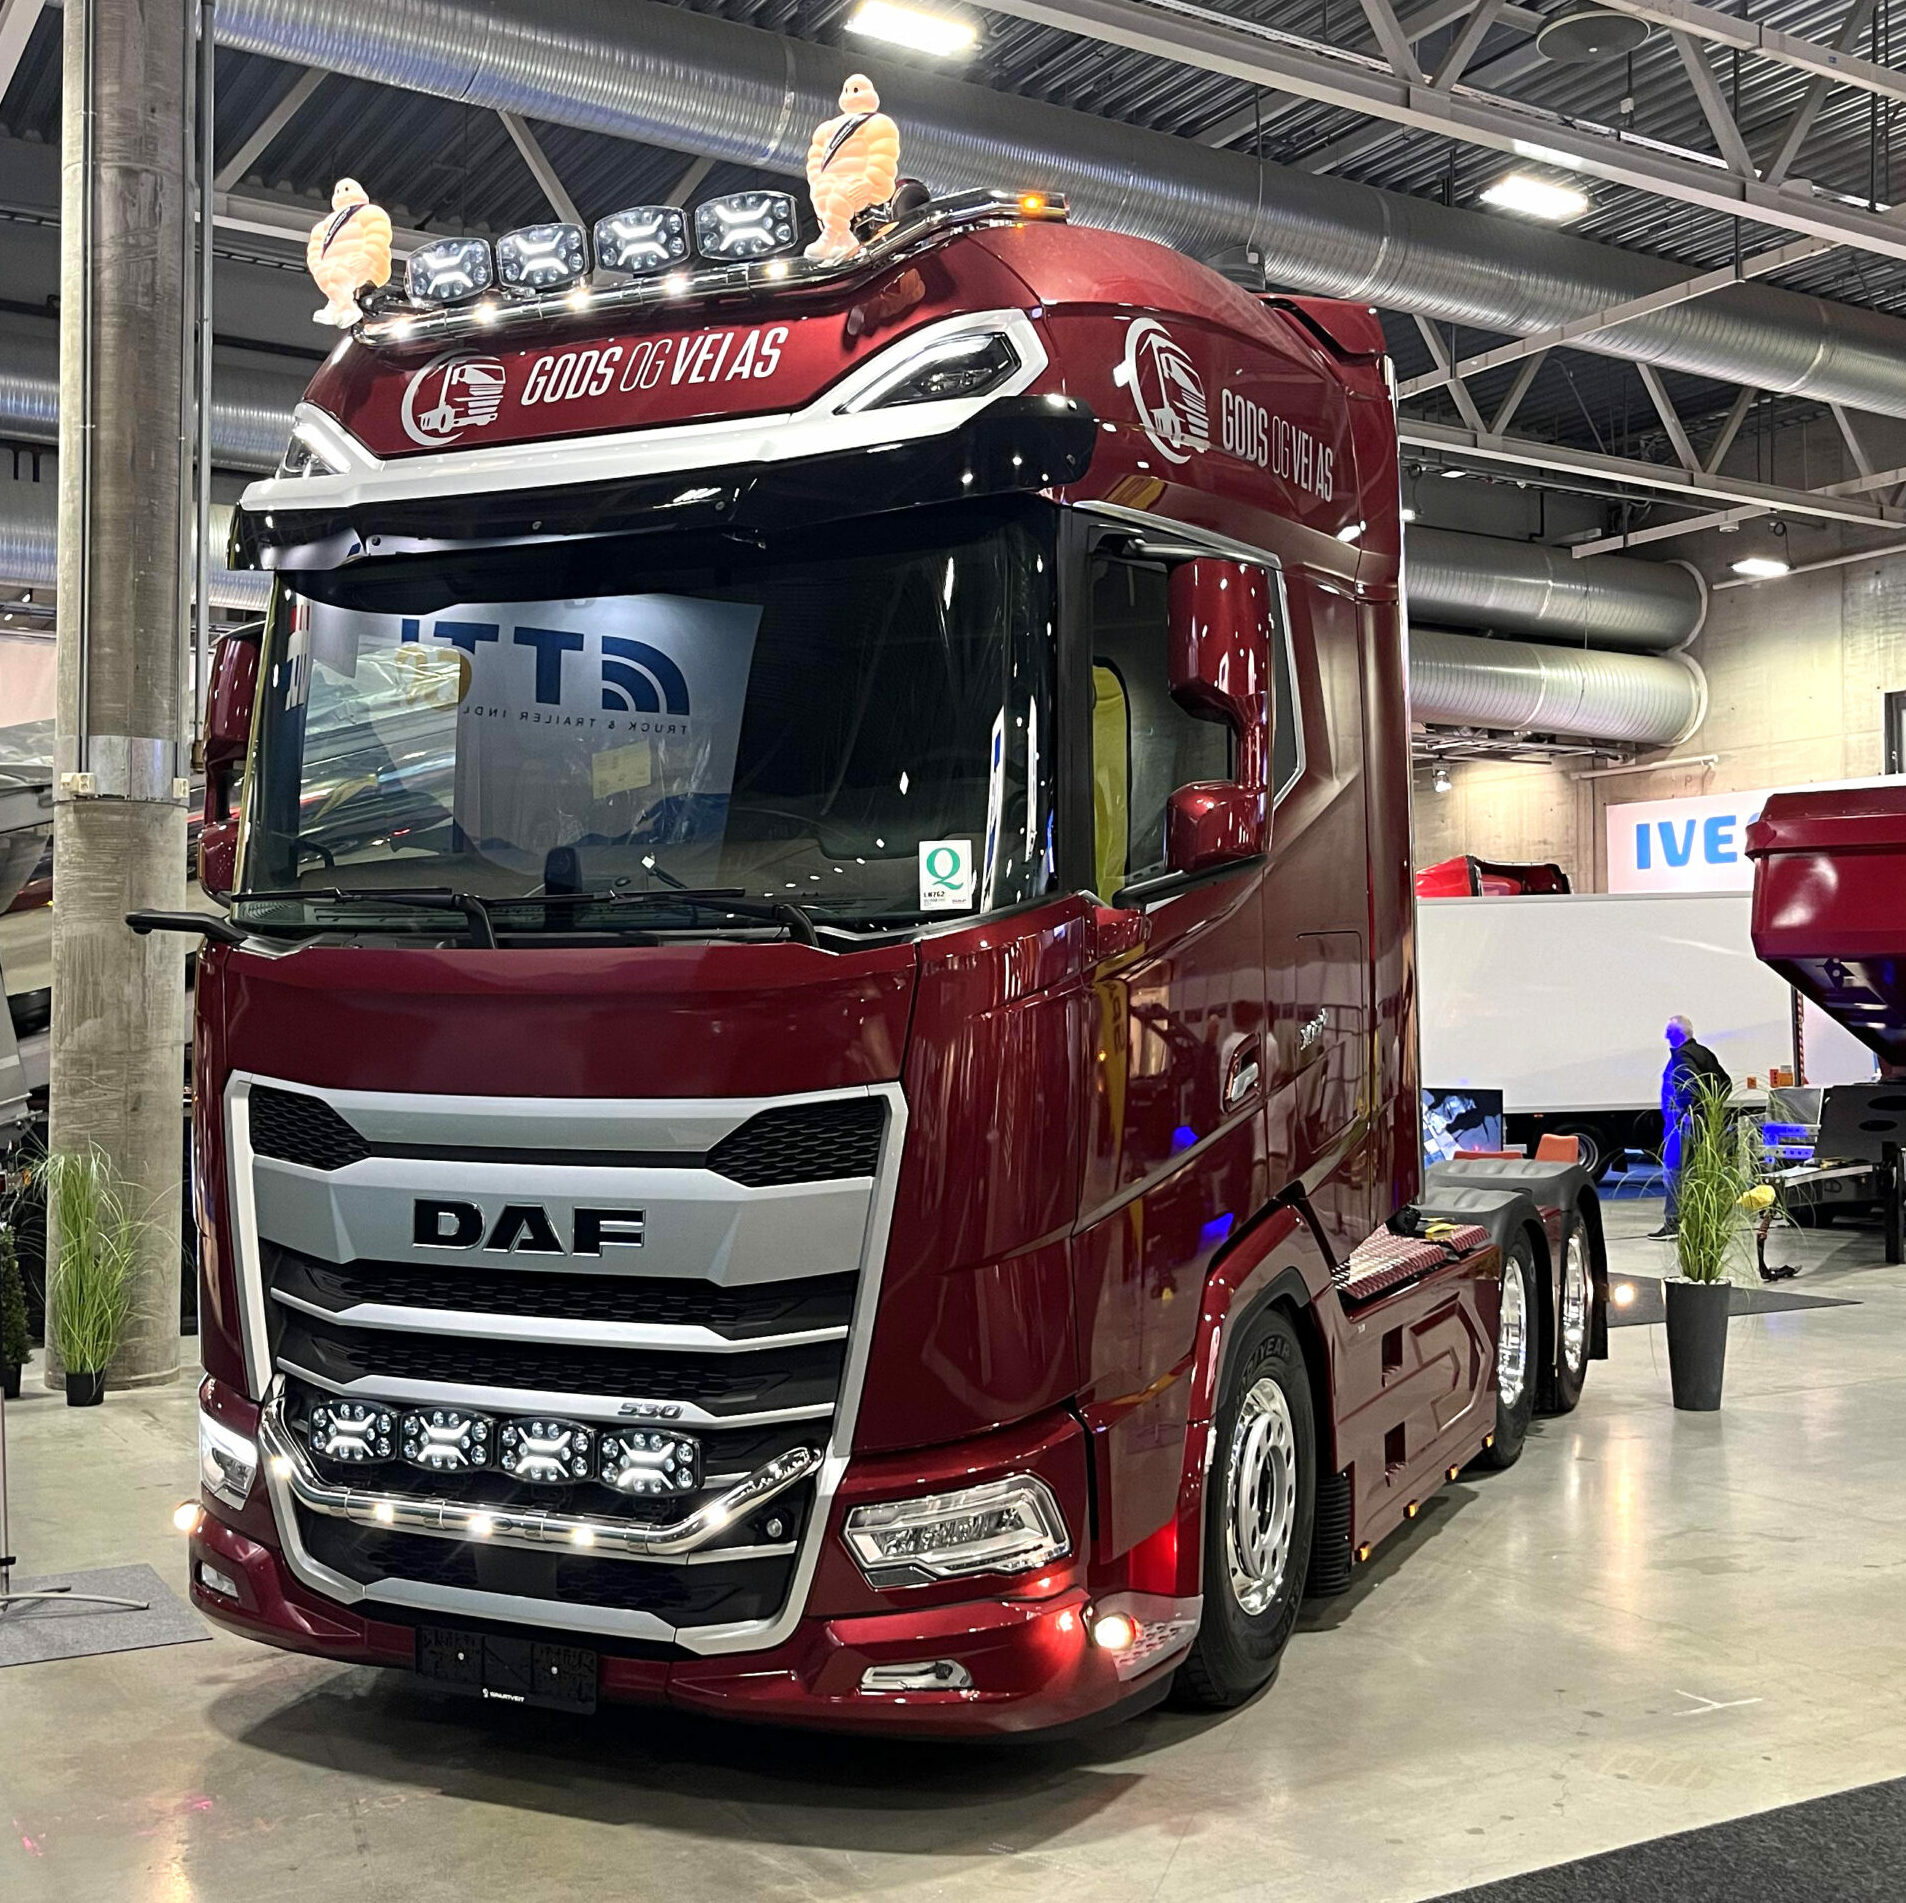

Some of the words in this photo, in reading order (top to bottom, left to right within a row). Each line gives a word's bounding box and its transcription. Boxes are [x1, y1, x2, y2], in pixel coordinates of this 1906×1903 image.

[521, 345, 622, 406] GODS
[619, 338, 672, 392] OG
[671, 331, 735, 386] VEI
[728, 327, 788, 381] AS
[1221, 388, 1268, 468] GODS
[1272, 415, 1290, 479] OG
[926, 847, 964, 890] Q
[1635, 812, 1761, 870] IVE
[413, 1198, 646, 1257] DAF
[618, 1402, 686, 1420] 530
